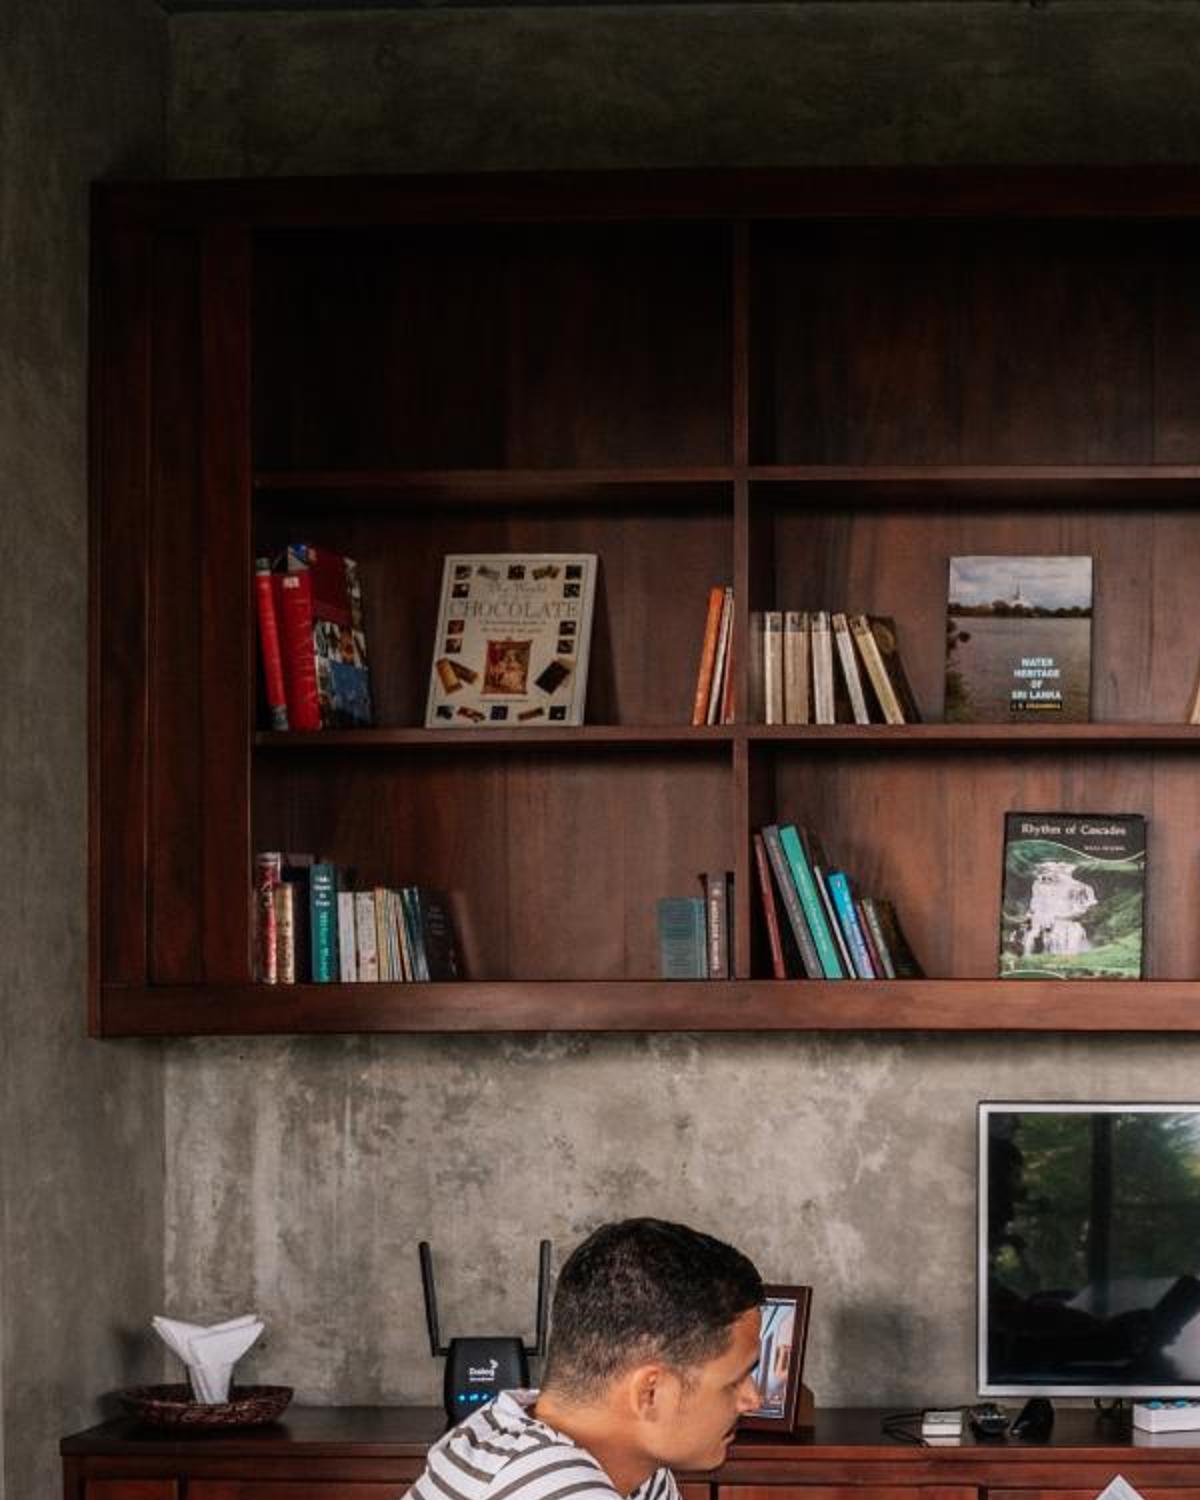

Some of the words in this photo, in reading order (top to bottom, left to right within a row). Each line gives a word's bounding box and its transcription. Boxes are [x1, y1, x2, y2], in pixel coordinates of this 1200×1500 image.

[1021, 657, 1054, 667] WATER
[1013, 668, 1061, 678] HERITAGE
[1021, 823, 1062, 837] Rhythm
[1065, 823, 1078, 836] of
[1080, 823, 1127, 836] Cascades
